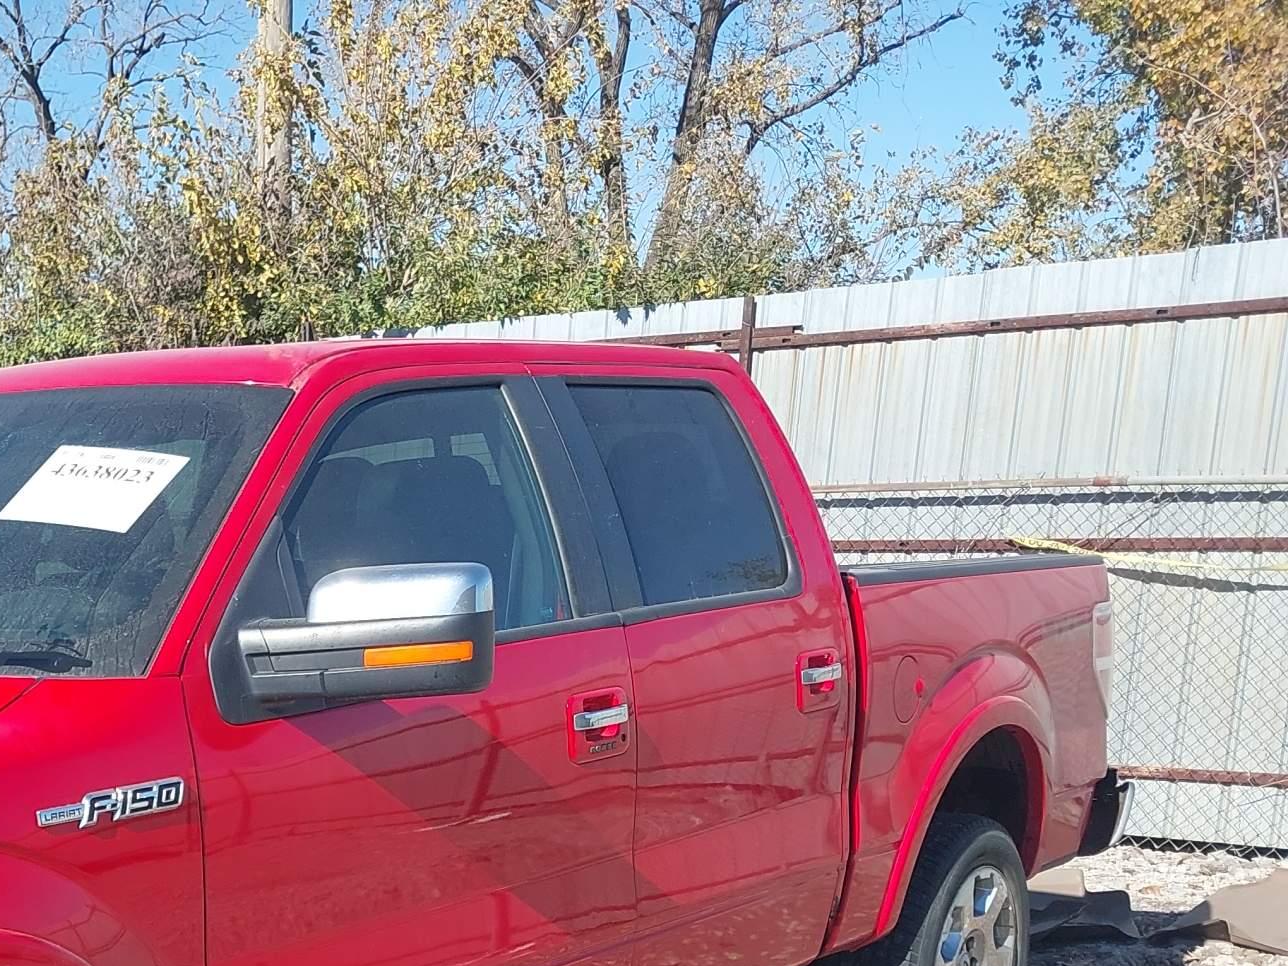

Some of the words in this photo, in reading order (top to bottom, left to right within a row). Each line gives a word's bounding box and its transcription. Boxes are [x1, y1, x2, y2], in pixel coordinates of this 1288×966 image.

[51, 463, 155, 484] 43638023
[43, 806, 83, 822] LARIAT
[81, 777, 184, 827] F-150
